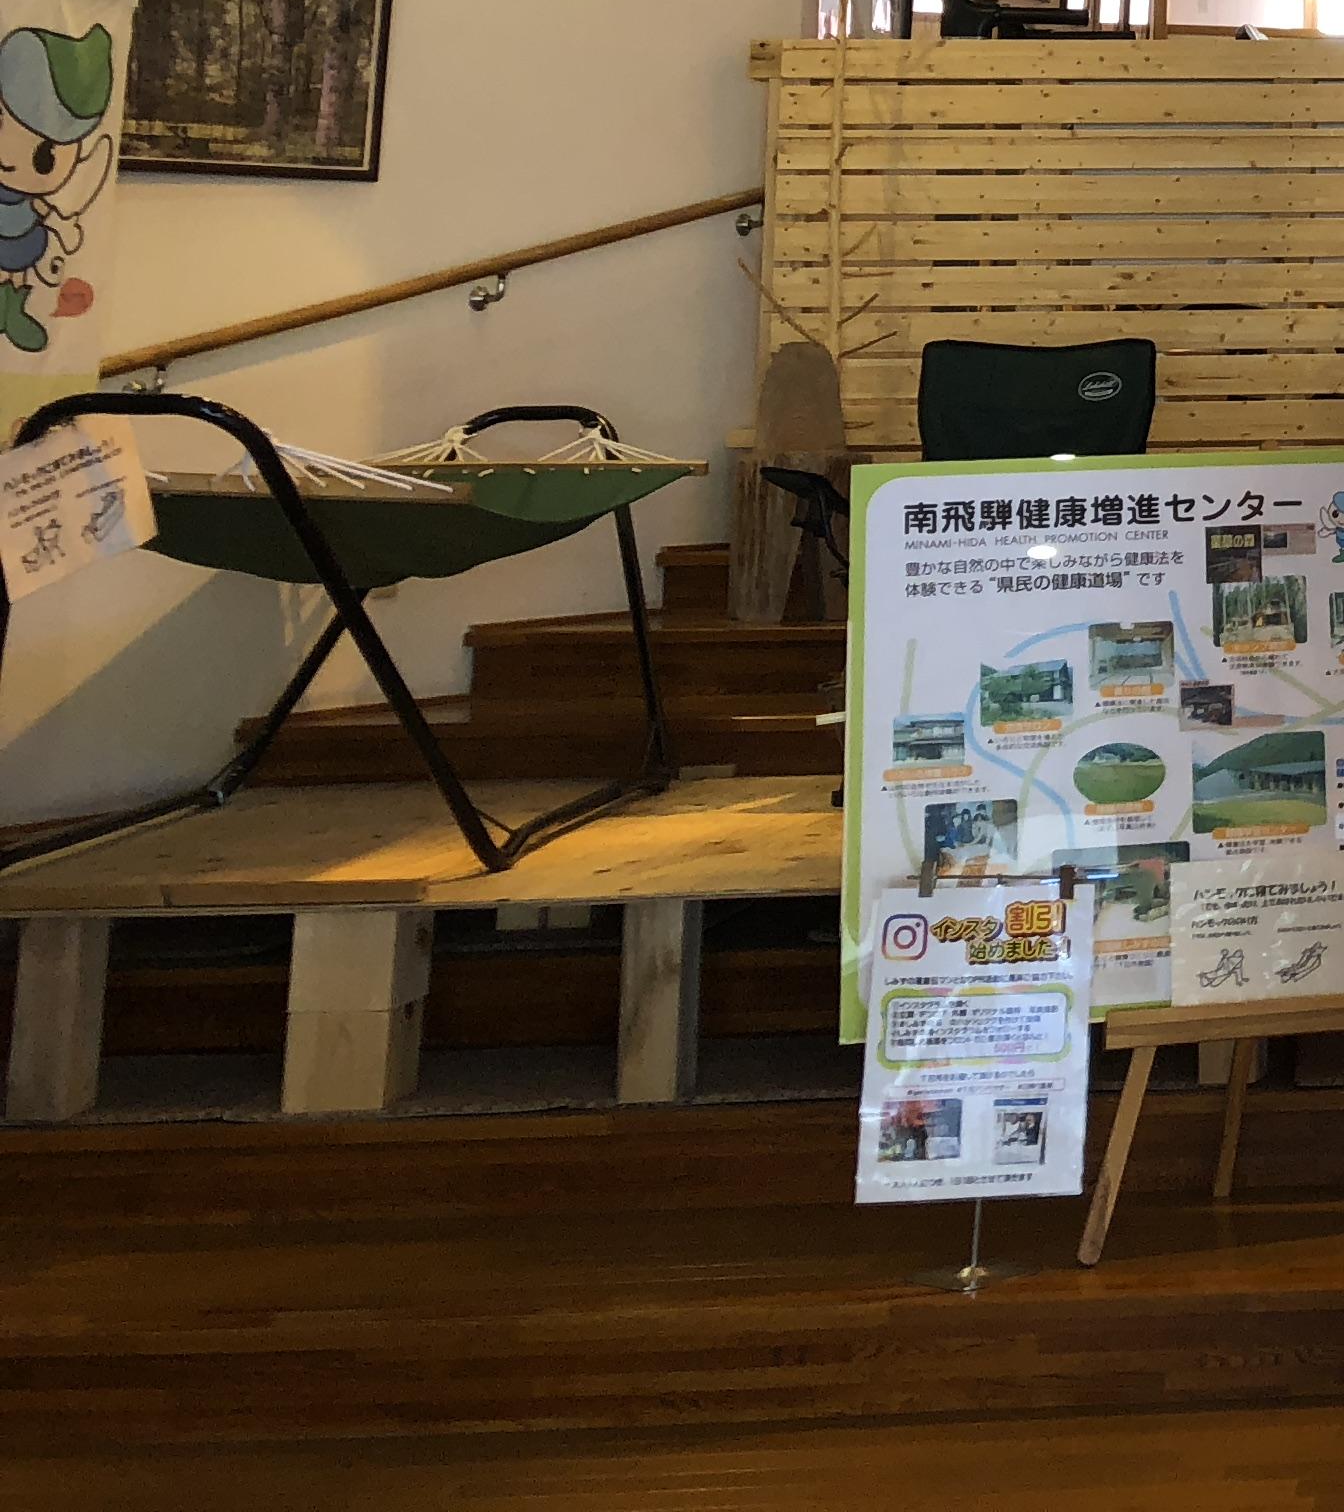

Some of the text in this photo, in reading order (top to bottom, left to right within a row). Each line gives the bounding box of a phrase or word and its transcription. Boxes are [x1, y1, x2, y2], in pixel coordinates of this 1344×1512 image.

[903, 490, 1303, 535] 南飛騨健康増進センター
[904, 529, 1169, 550] MINAMI-HIDA HEALTH PROMOTION CENTER
